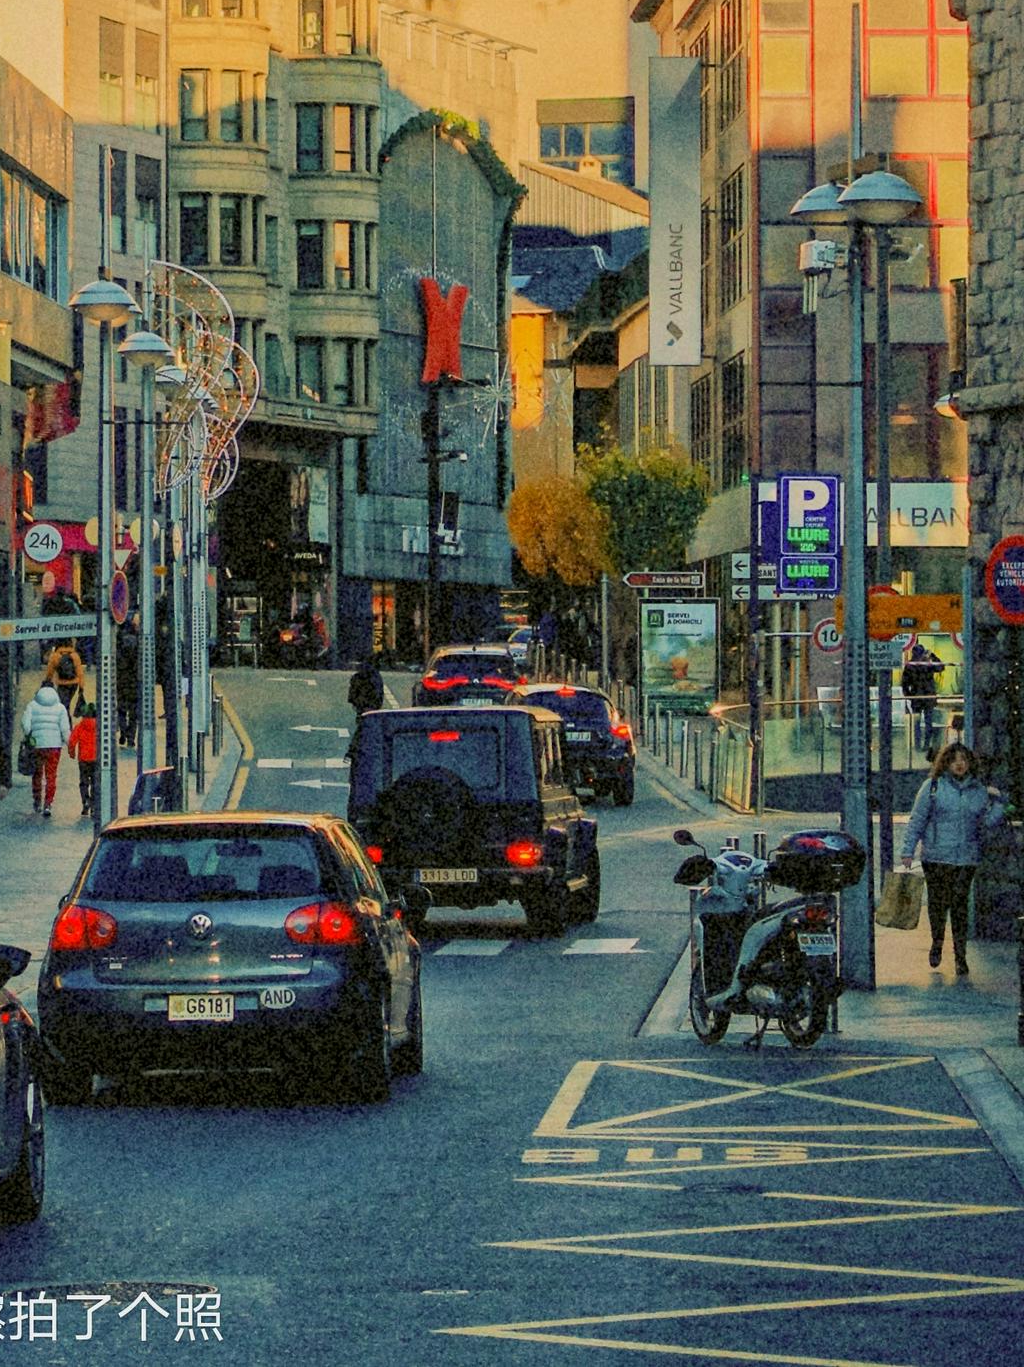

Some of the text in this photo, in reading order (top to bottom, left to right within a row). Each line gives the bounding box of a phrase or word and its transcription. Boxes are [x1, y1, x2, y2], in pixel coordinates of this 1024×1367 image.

[669, 224, 683, 315] VALLBANC
[789, 480, 830, 528] P
[29, 532, 58, 549] 24h
[787, 528, 830, 541] LLIURE
[821, 630, 839, 643] 10
[264, 989, 293, 1005] AND
[186, 998, 231, 1014] G6181
[522, 1147, 808, 1163] BUS
